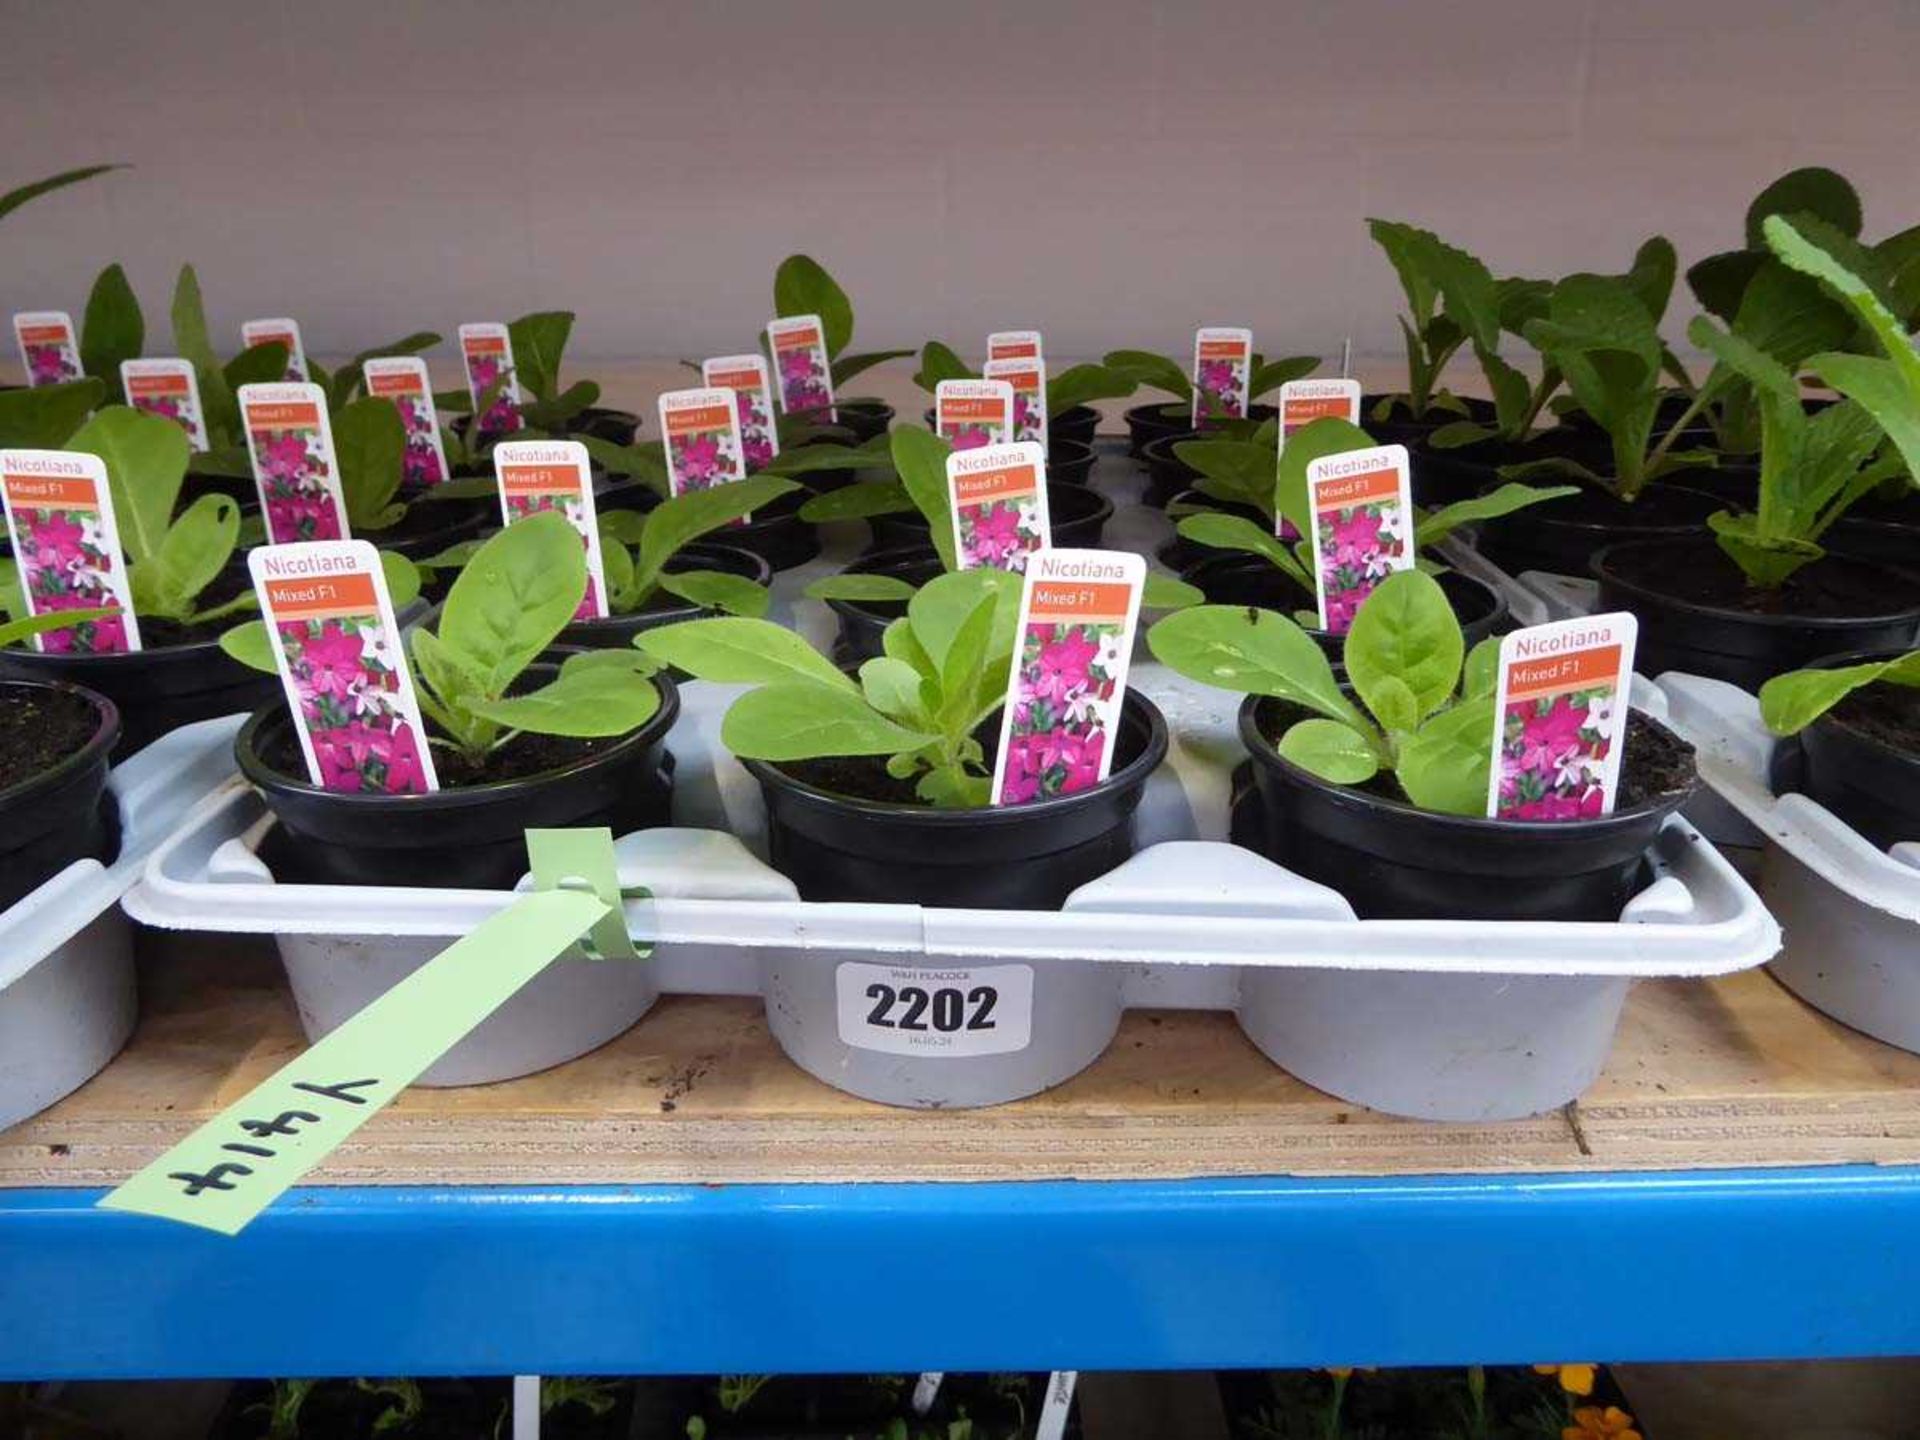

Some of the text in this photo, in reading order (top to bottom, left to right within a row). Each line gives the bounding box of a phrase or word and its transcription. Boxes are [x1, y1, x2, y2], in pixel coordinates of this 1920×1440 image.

[943, 385, 998, 396] Nicotiana
[1288, 383, 1346, 397] Nicotiana
[4, 455, 84, 475] Nicotiana
[503, 449, 570, 462] Nicotiana
[957, 451, 1026, 472] Nicotiana
[1317, 455, 1390, 478] Nicotiana
[8, 480, 65, 495] Mixed F1
[506, 471, 553, 484] Mixed F1
[960, 474, 1008, 494] Mixed F1
[1319, 478, 1370, 499] Mixed F1
[263, 553, 358, 576] Nicotiana
[1041, 557, 1126, 579] Nicotiana
[272, 584, 338, 603] Mixed F1
[1036, 590, 1096, 606] Mixed F1
[1515, 628, 1612, 657] Nicotiana
[1512, 659, 1580, 685] Mixed F1
[919, 972, 969, 981] PEACOCK
[866, 983, 998, 1032] 2202
[168, 1079, 379, 1196] Y 414
